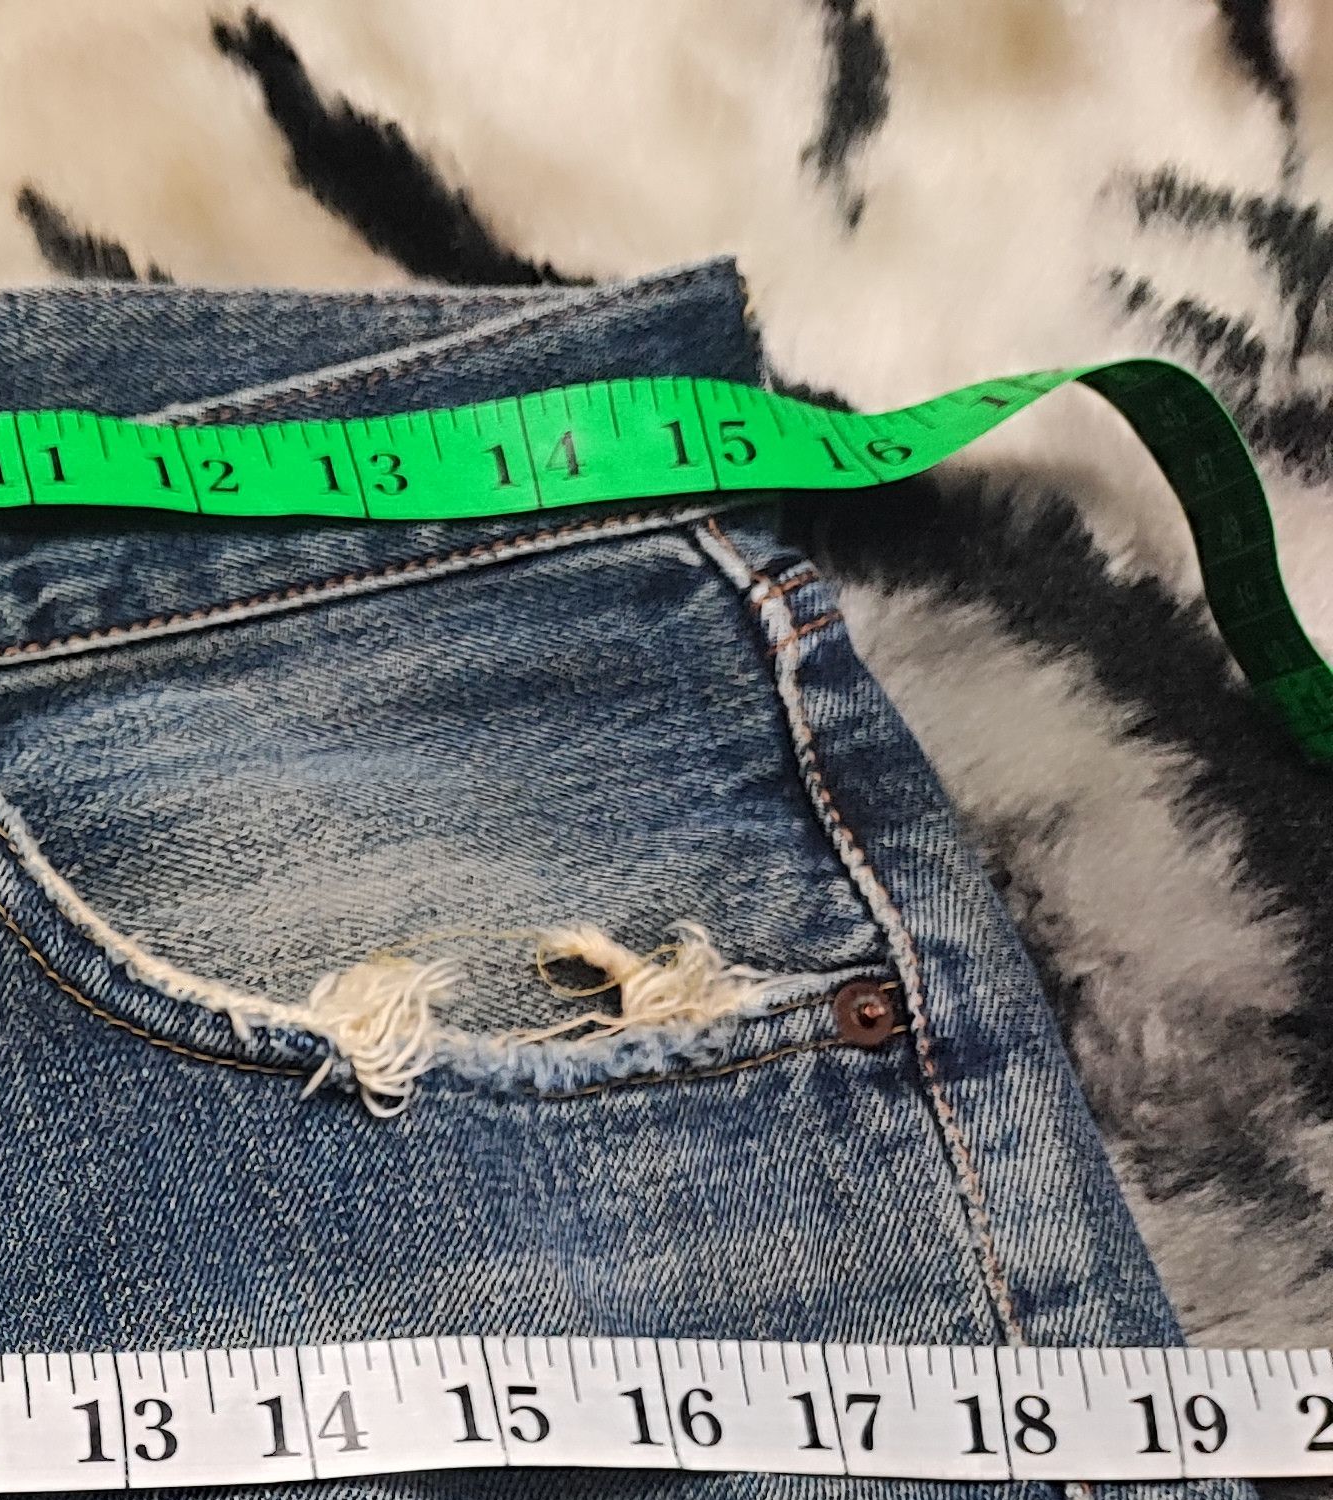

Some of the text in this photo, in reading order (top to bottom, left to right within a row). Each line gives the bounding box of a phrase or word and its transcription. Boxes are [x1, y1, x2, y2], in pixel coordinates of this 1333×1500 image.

[147, 454, 240, 494] 12
[311, 452, 409, 496] 13
[483, 430, 585, 490] 14
[661, 419, 758, 469] 15
[813, 436, 913, 473] 16
[967, 394, 1011, 409] 1
[72, 1397, 178, 1463] 13
[256, 1389, 369, 1458] 14
[443, 1383, 550, 1444] 15
[619, 1386, 723, 1447] 16
[786, 1390, 882, 1451] 17
[956, 1393, 1057, 1455] 18
[1127, 1393, 1229, 1455] 19
[1297, 1394, 1333, 1453] 2
